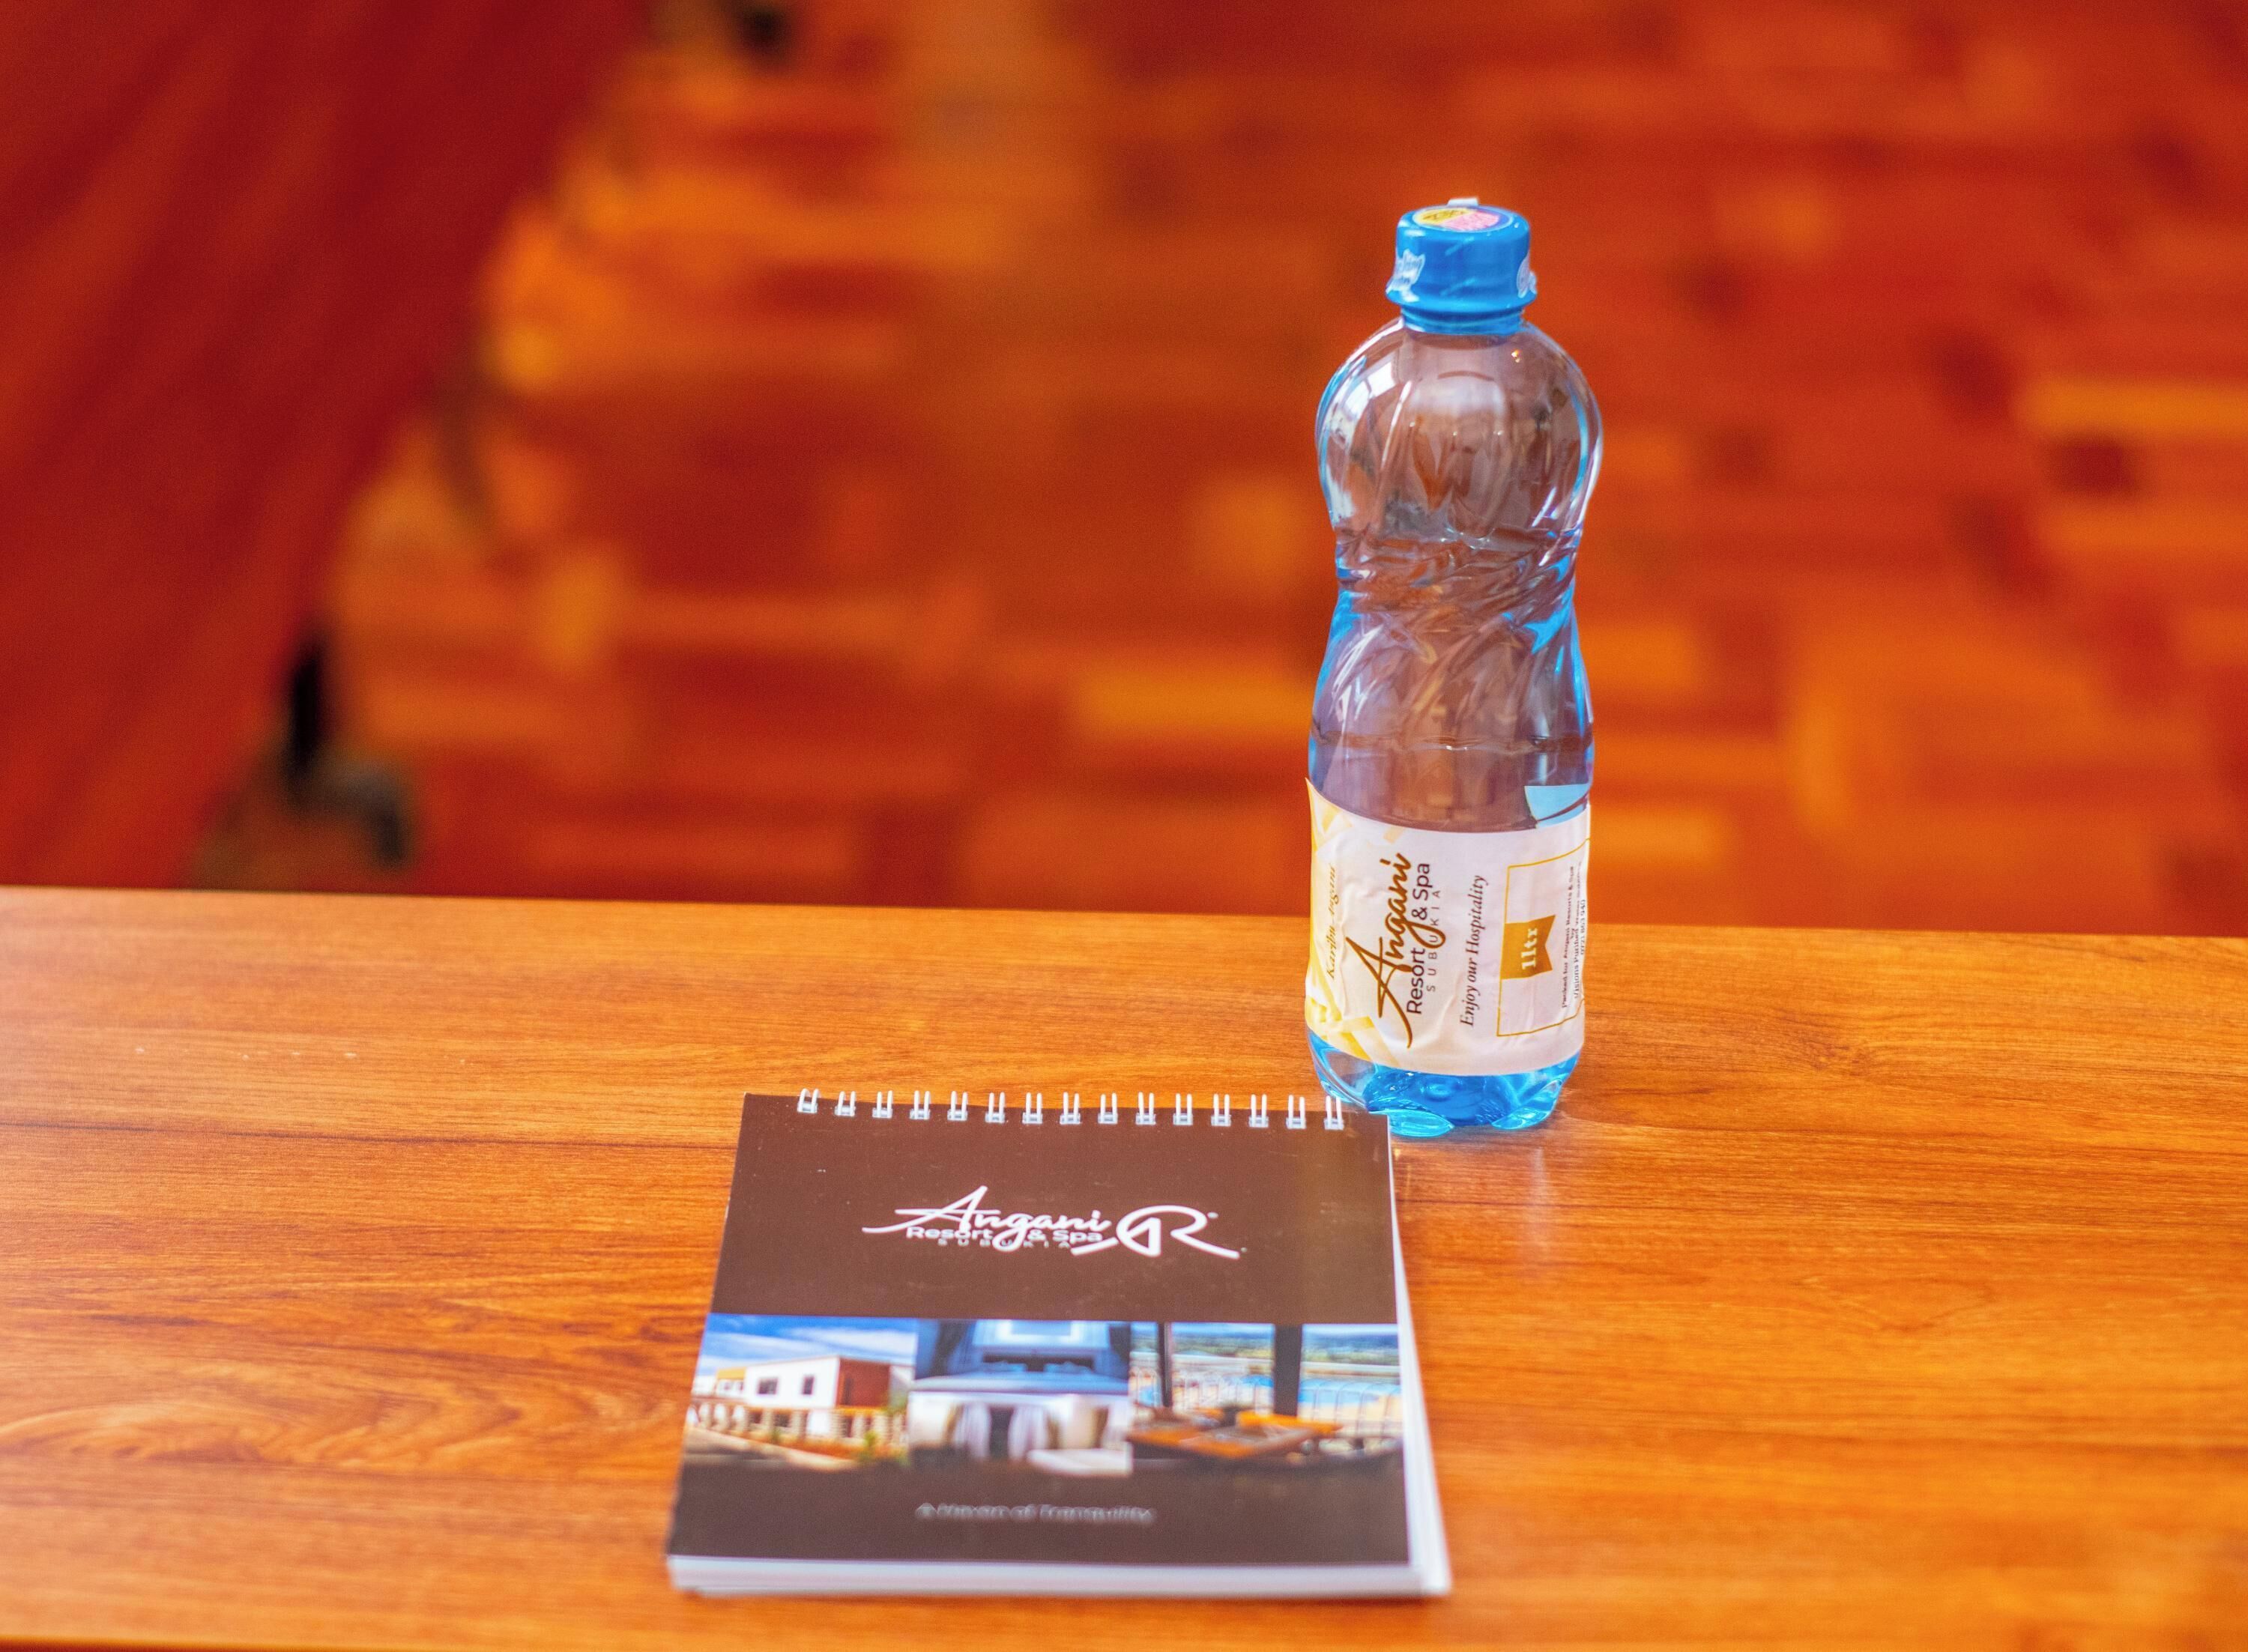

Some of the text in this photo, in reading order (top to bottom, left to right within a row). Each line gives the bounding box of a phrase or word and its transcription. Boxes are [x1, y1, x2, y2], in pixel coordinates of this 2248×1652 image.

[1345, 853, 1446, 1049] Angani
[1406, 863, 1433, 1014] Resort & Spa
[1426, 889, 1441, 993] SUBUKIA
[1460, 874, 1489, 1026] Enjoy our Hospitality
[862, 1185, 1112, 1252] Angani
[906, 1225, 1103, 1245] Resort & Spa
